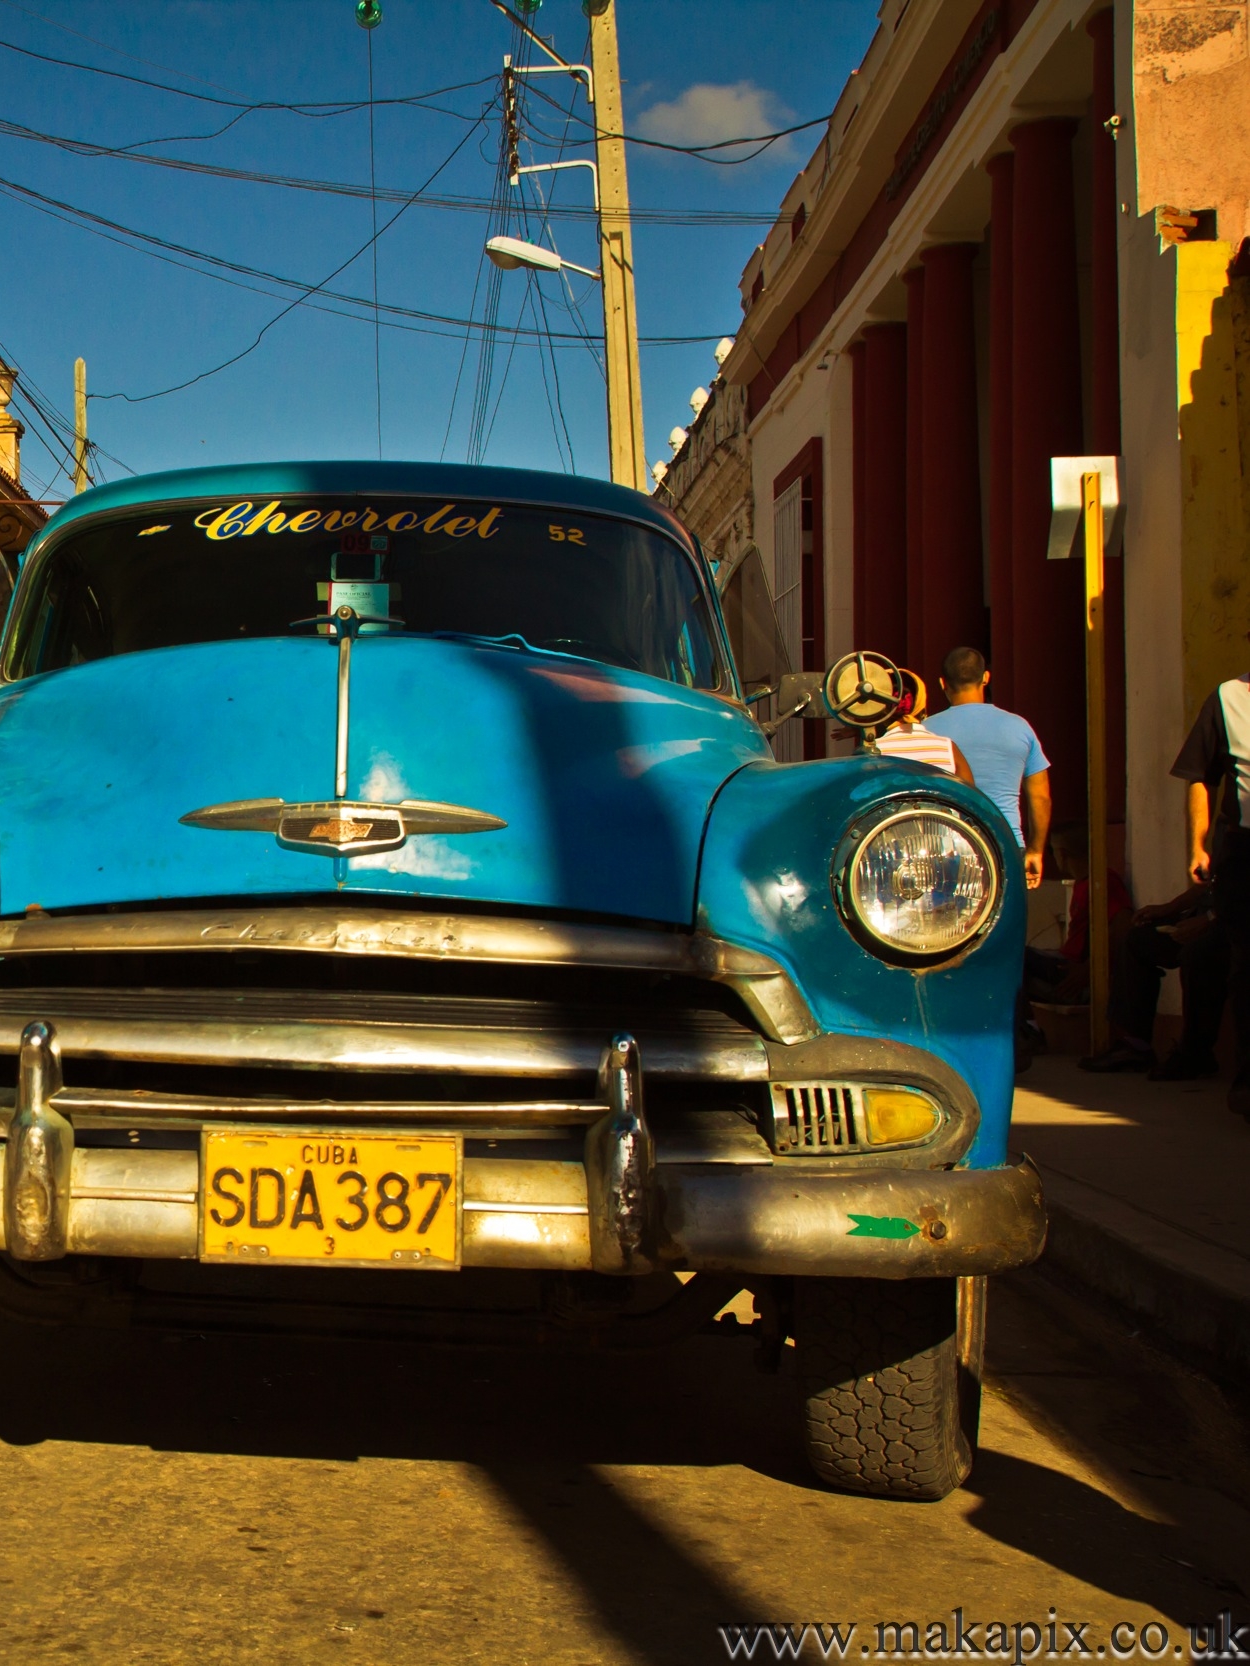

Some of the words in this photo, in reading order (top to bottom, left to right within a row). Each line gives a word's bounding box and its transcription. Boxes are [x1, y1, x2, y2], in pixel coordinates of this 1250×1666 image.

[194, 500, 505, 541] Chevrolet
[548, 524, 588, 546] 52
[301, 1144, 359, 1165] CUBA
[323, 1236, 336, 1255] 3
